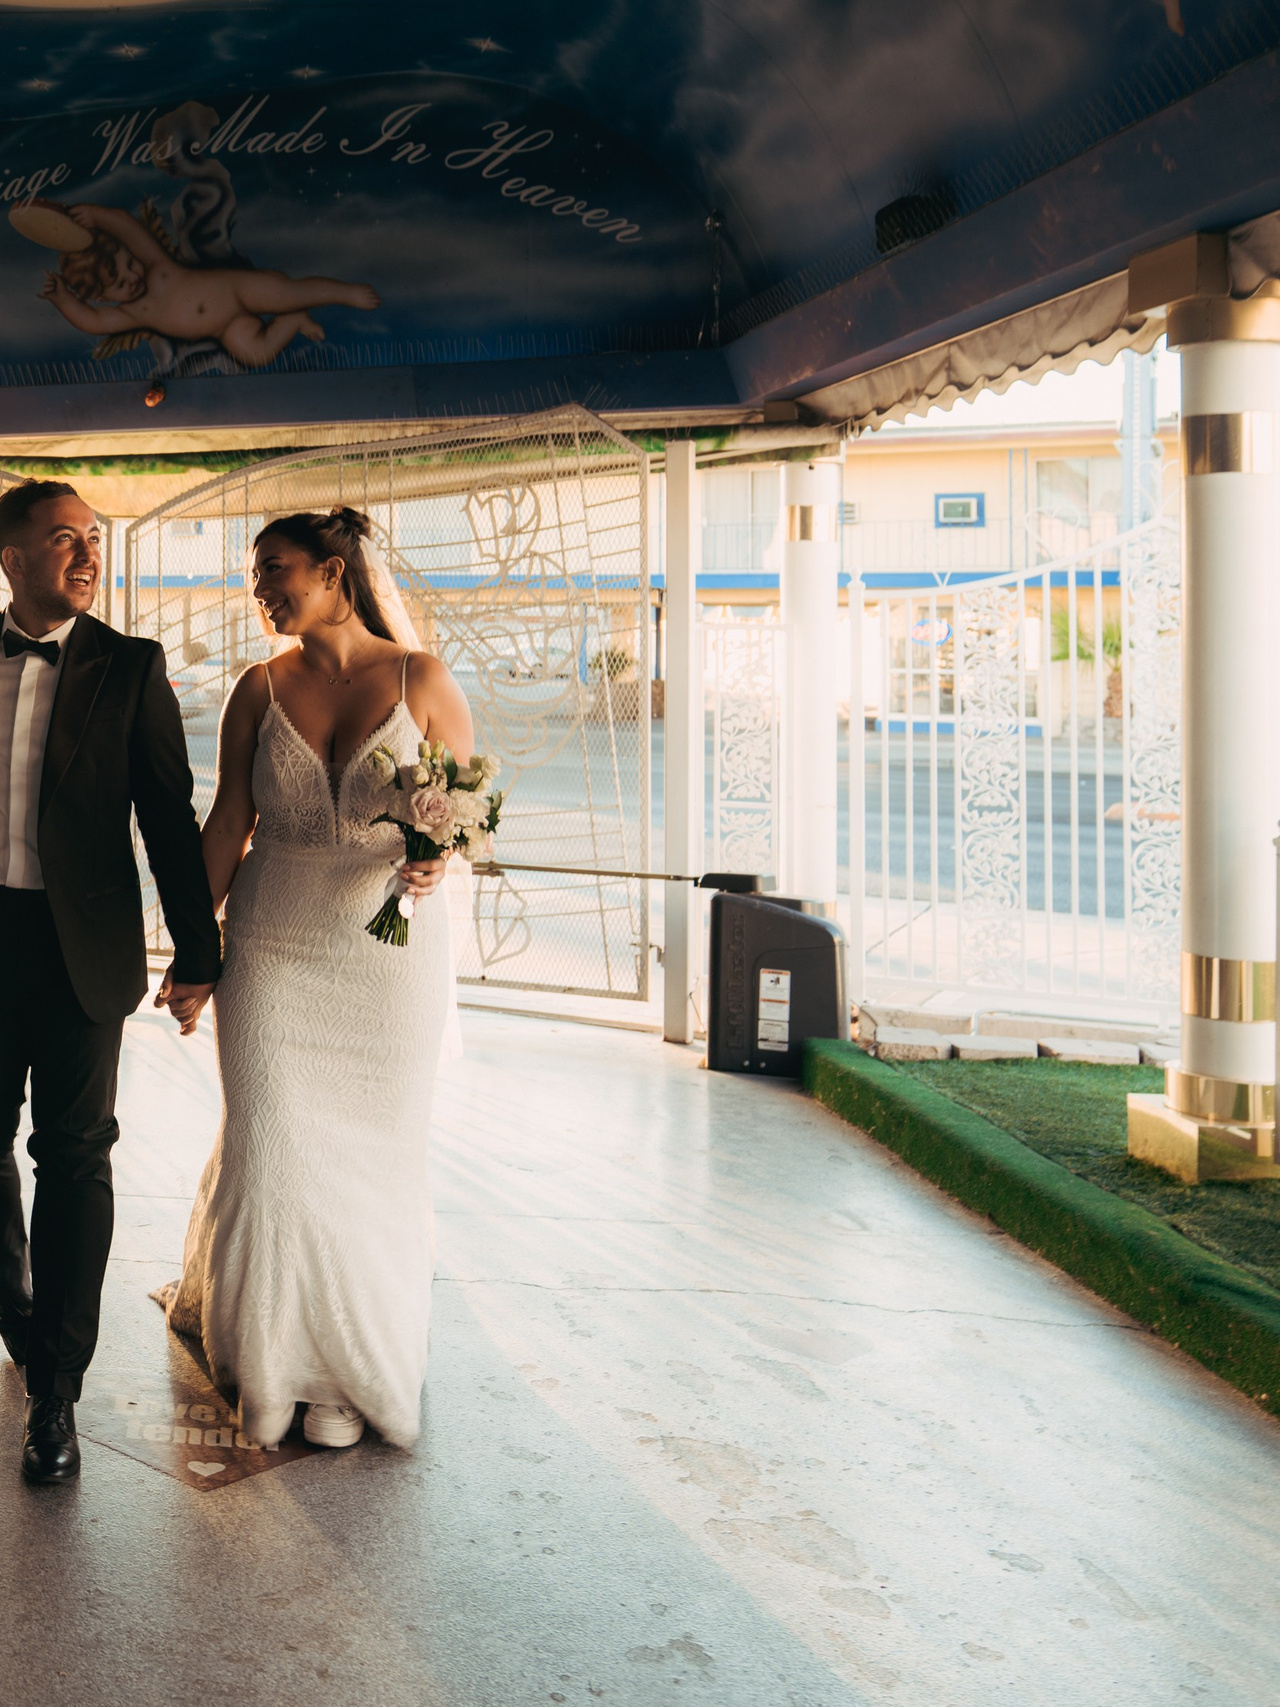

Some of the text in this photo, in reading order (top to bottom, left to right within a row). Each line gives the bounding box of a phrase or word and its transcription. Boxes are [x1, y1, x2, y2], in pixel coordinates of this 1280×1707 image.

[92, 107, 181, 177] Was
[190, 94, 327, 155] Made
[339, 103, 431, 164] In
[445, 121, 643, 243] Heaven
[126, 1418, 280, 1451] tende
